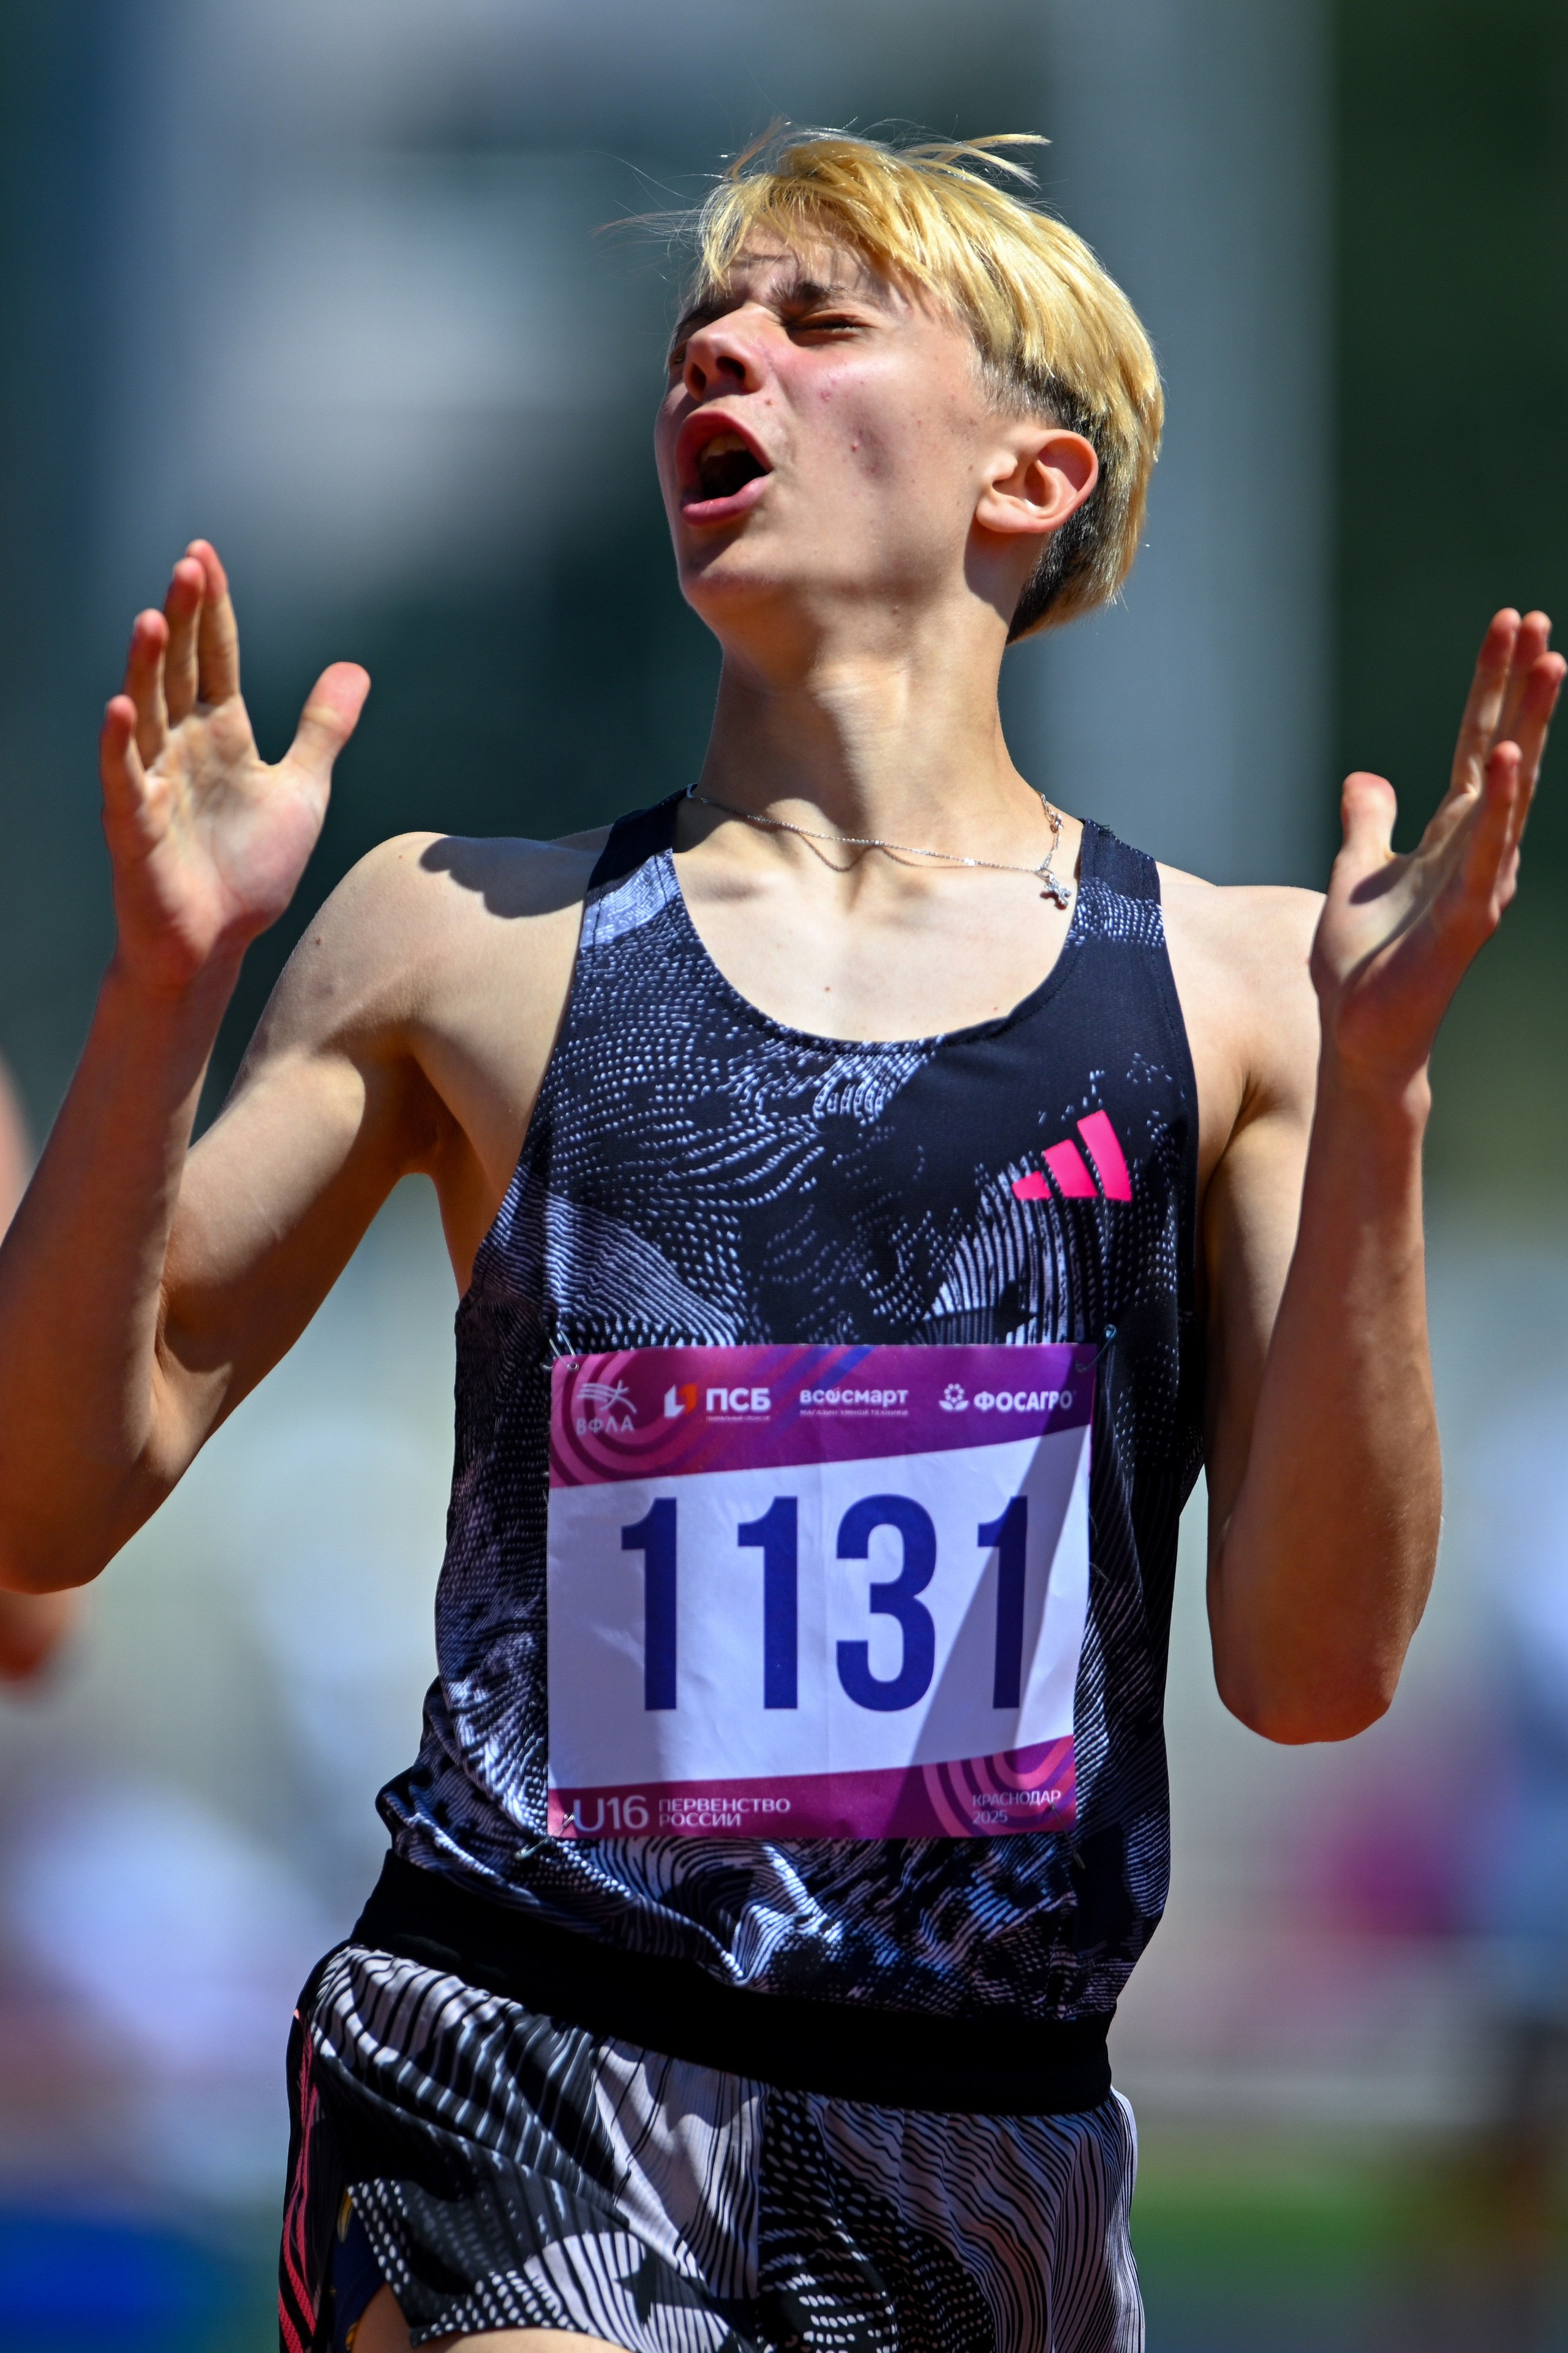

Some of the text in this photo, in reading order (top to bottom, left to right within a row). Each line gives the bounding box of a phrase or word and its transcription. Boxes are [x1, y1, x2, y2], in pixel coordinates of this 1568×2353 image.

[706, 1388, 771, 1413] ПСБ
[974, 1390, 1072, 1411] ФОСАГРО
[576, 1414, 635, 1435] ВФЛА
[621, 1494, 1028, 1712] 1131
[659, 1798, 791, 1813] ПЕРВЕНСТВО
[972, 1789, 1061, 1807] КРАСНОДАР
[573, 1795, 649, 1832] U16
[659, 1812, 742, 1827] РОССИИ
[972, 1810, 1008, 1824] 2025
